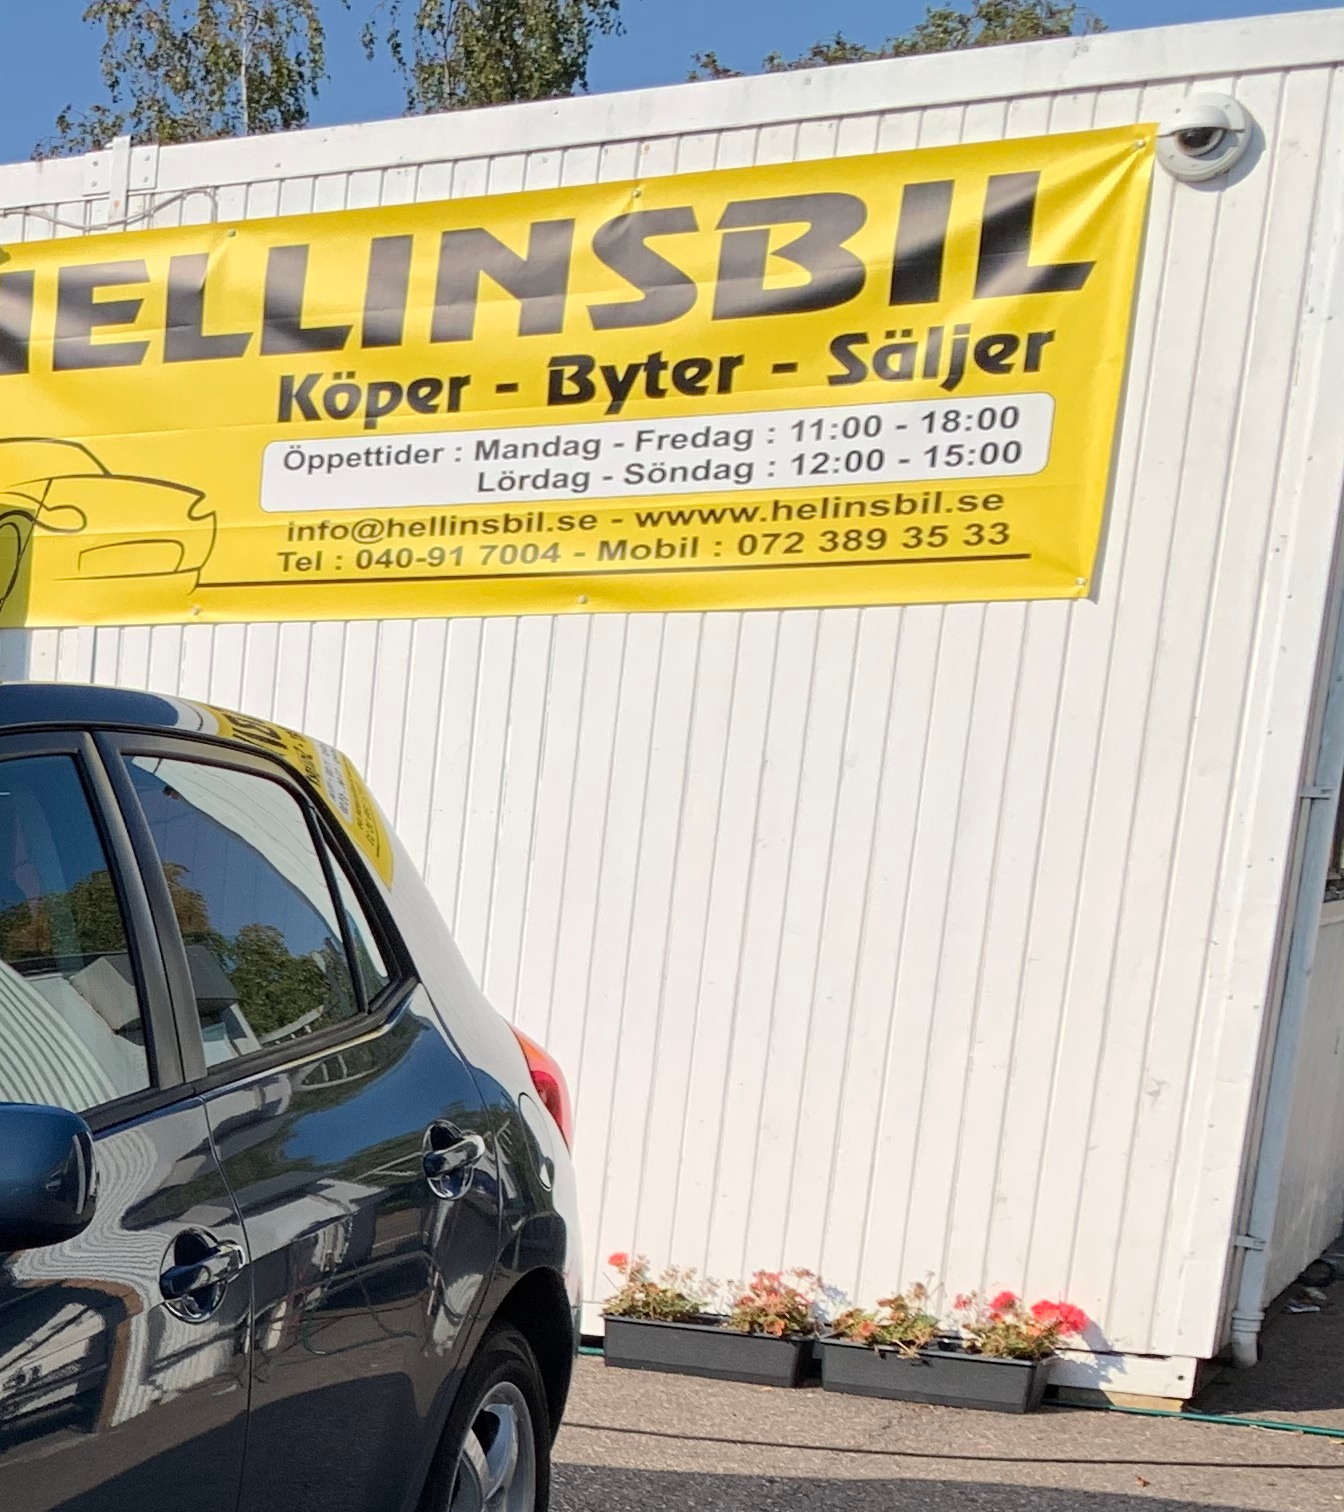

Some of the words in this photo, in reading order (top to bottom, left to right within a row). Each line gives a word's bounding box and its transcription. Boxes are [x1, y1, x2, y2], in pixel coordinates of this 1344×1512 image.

[277, 371, 471, 430] Köper
[546, 351, 745, 414] Byter
[827, 323, 1056, 391] Säljer
[283, 444, 445, 475] Öppettider
[474, 435, 602, 460] Mandag
[635, 425, 754, 452] Fredag
[790, 414, 882, 443] 11:00
[921, 405, 1020, 435] 18:00
[477, 468, 591, 493] Lördag
[624, 459, 754, 485] Söndag
[791, 448, 884, 477] 12:00
[923, 440, 1022, 469] 15:00
[286, 511, 599, 544] info@hellinsbil.se
[635, 491, 1005, 528] wwww.helinsbil.se
[277, 550, 323, 572] Tel
[356, 545, 464, 570] 040-91
[479, 541, 562, 566] 7004
[597, 537, 699, 563] Mobil
[737, 531, 804, 557] 072
[818, 527, 888, 553] 389
[902, 525, 949, 550] 35
[963, 521, 1010, 547] 33
